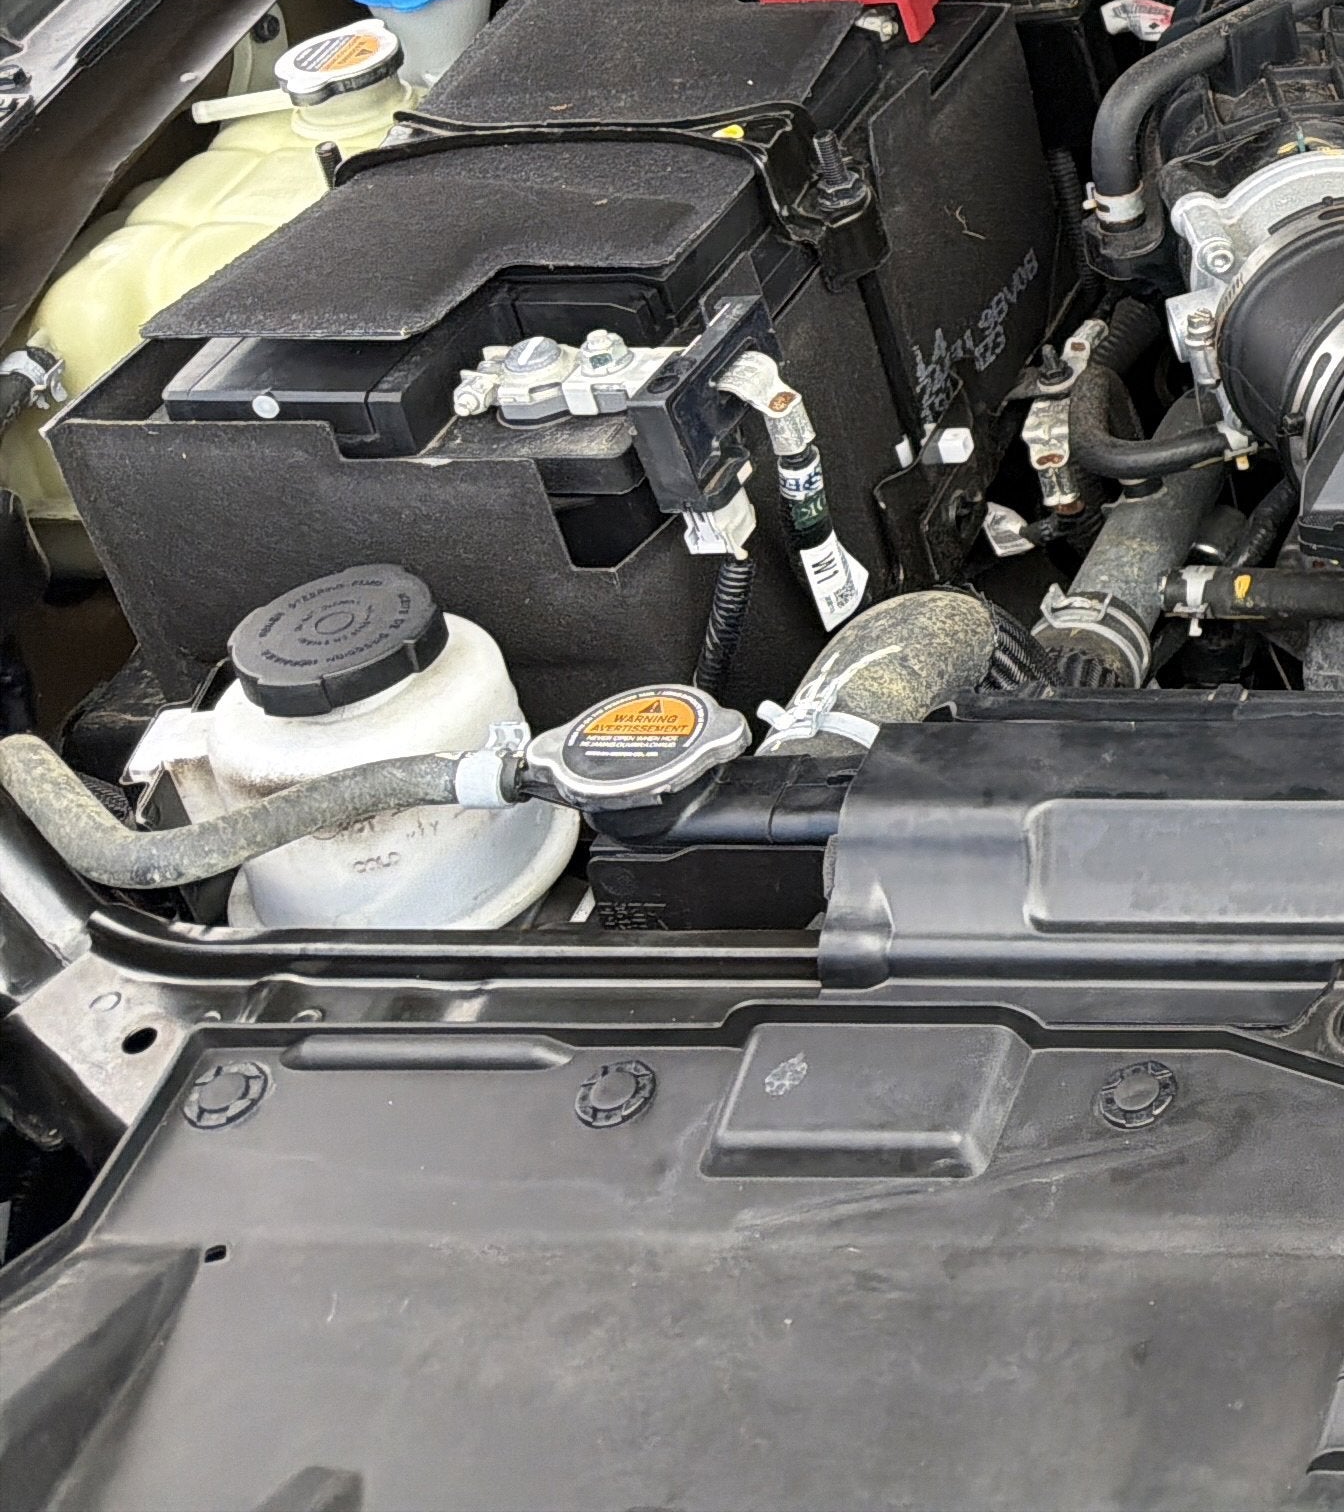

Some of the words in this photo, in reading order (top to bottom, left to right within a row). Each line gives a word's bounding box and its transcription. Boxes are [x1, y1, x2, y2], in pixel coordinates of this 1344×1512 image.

[811, 551, 840, 585] W1
[614, 714, 679, 723] WARNING
[590, 724, 689, 733] AVERTISSEMENT
